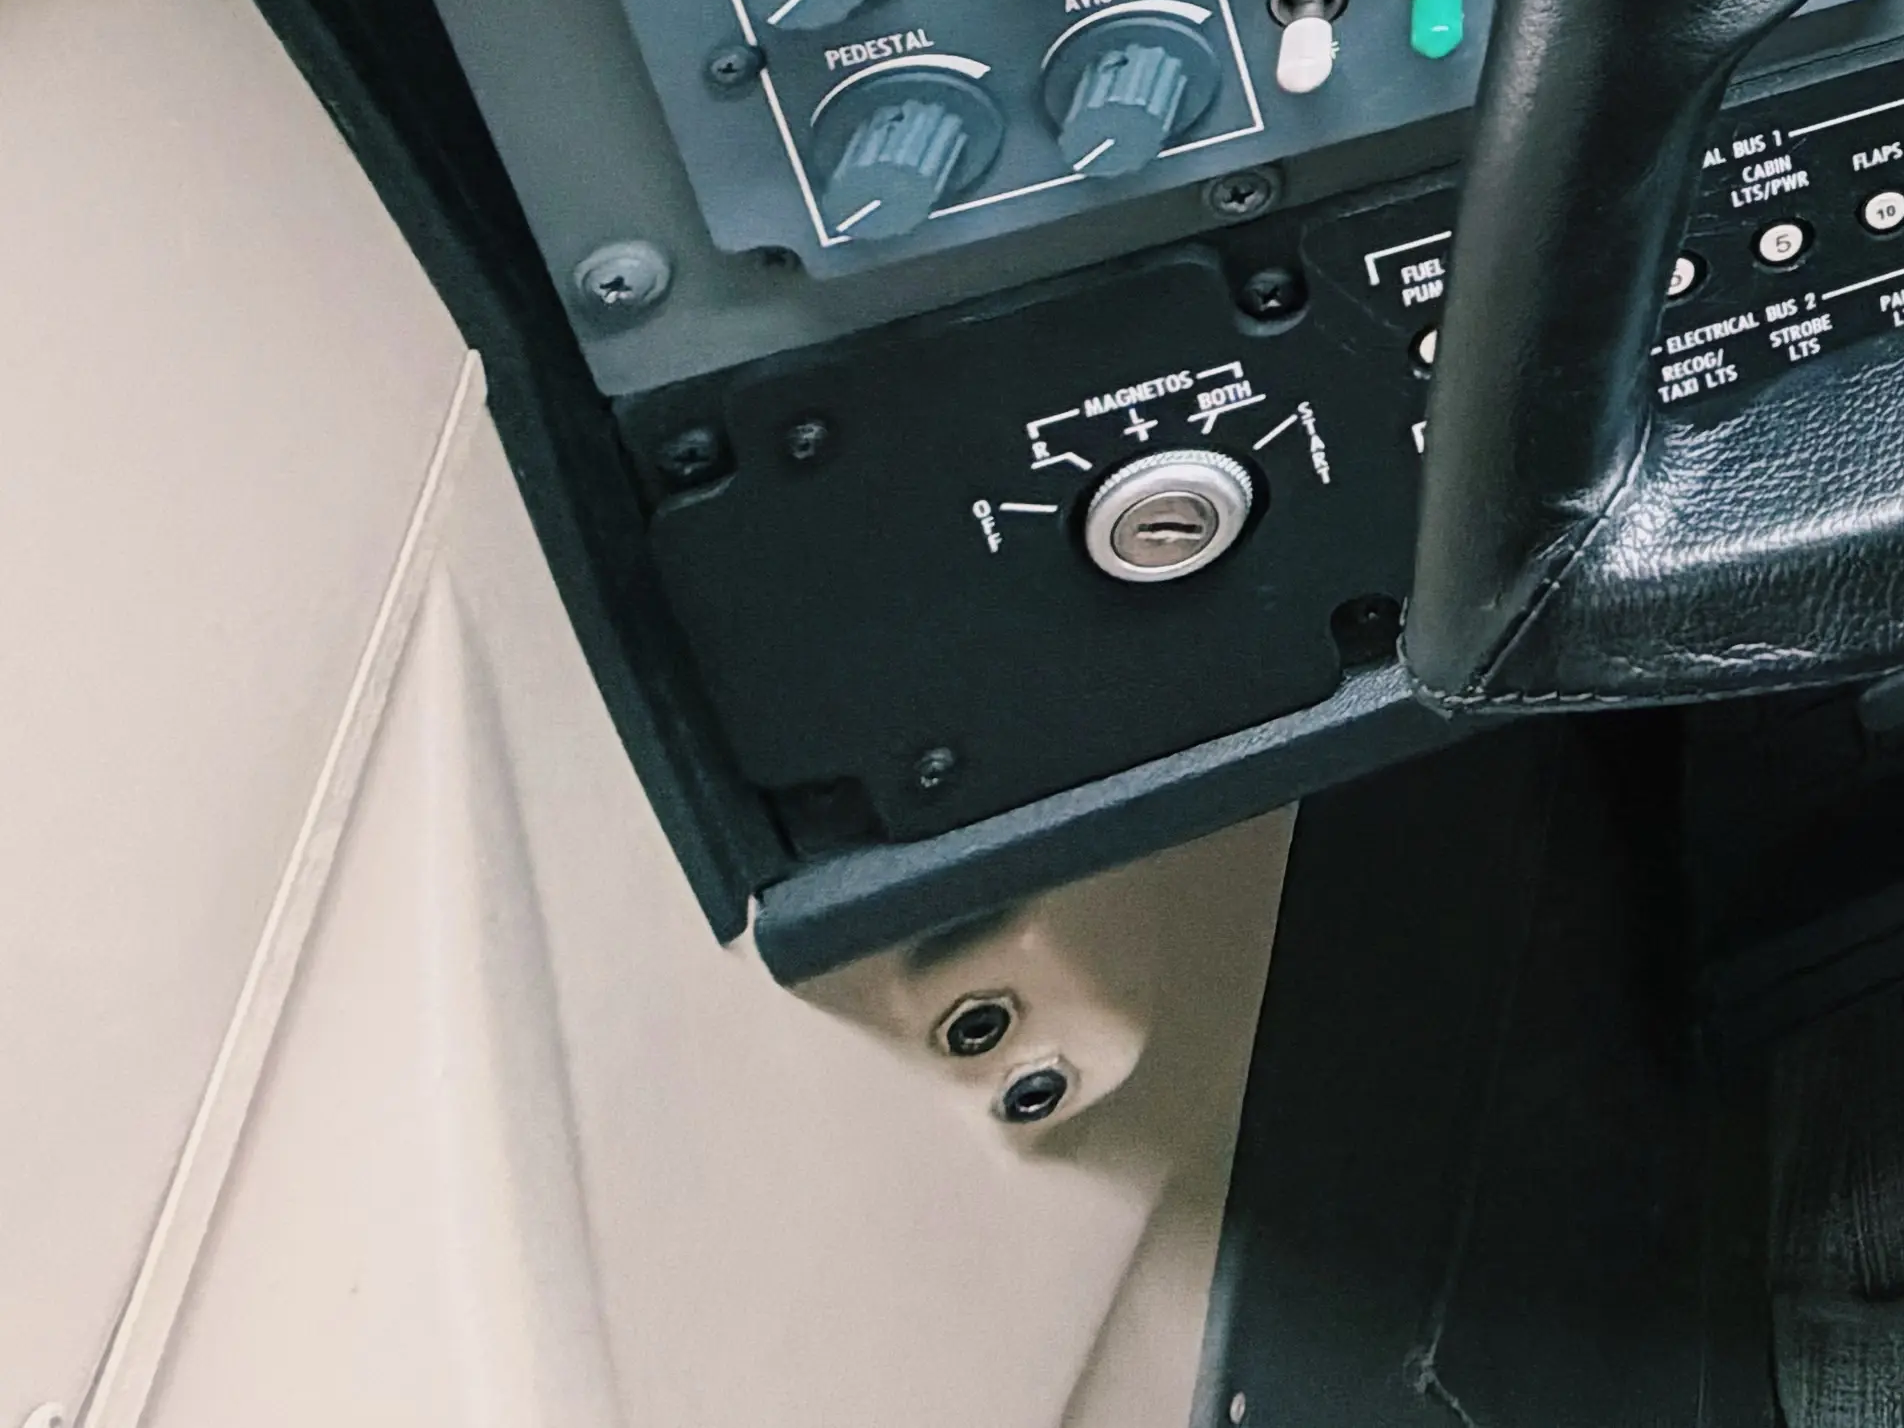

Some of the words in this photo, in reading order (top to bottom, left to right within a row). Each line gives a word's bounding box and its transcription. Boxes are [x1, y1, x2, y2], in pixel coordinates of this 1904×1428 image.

[824, 28, 935, 70] PEDESTAL
[1742, 154, 1792, 183] CABIN
[1852, 141, 1904, 171] FLAPS
[1730, 170, 1810, 208] LTS/PWR
[1666, 312, 1760, 355] ELECTRICAL
[1765, 298, 1798, 323] BUS
[1804, 292, 1817, 311] 2
[1769, 313, 1833, 348] STROBE
[1788, 337, 1821, 361] LTS
[1084, 370, 1194, 420] MAGNETOS
[1198, 380, 1251, 410] BOTH
[1298, 400, 1331, 483] START
[972, 499, 1000, 552] OFF
